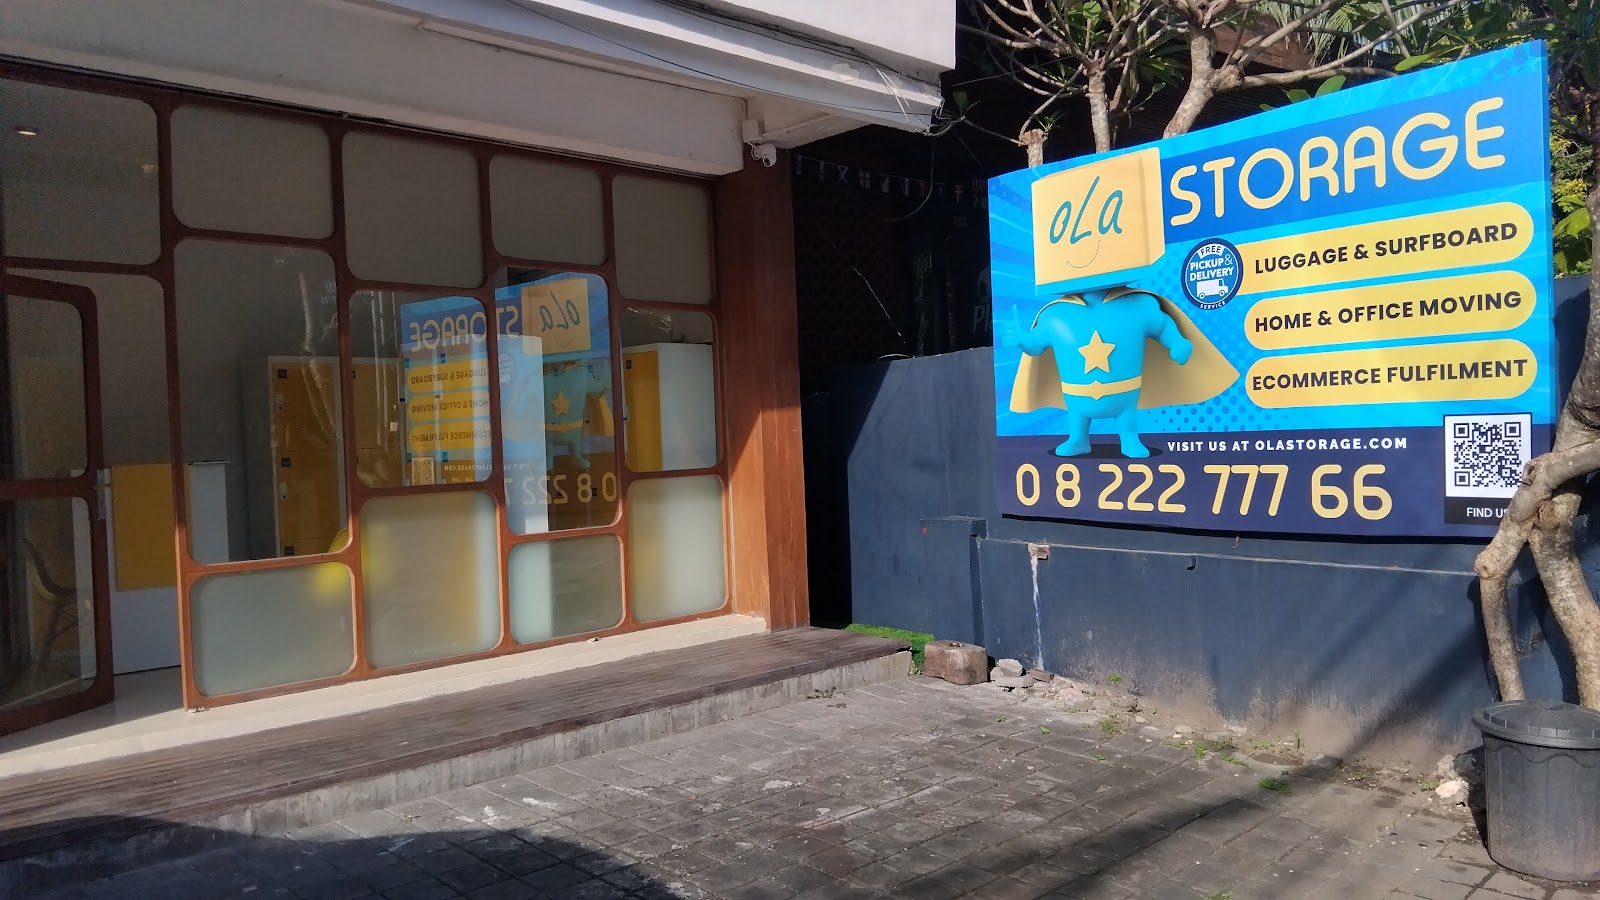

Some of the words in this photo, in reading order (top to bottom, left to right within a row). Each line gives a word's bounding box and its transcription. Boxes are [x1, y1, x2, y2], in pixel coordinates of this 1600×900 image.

[1169, 96, 1506, 227] STORAGE
[1200, 245, 1222, 256] FREE
[1255, 246, 1348, 275] LUGGAGE
[1353, 243, 1370, 260] &
[1375, 222, 1518, 257] SURFBOARD
[1189, 266, 1234, 282] DELIVERY
[972, 304, 992, 334] Pl
[1200, 301, 1226, 310] SERVICE
[1255, 310, 1311, 332] HOME
[1317, 310, 1333, 327] &
[1338, 301, 1413, 323] OFFICE
[1419, 290, 1522, 317] MOVING
[1252, 367, 1381, 391] ECOMMERCE
[1387, 358, 1528, 383] FULFILMENT
[1167, 441, 1203, 452] VISIT
[1208, 440, 1227, 451] US
[1232, 440, 1250, 451] AT
[1255, 437, 1407, 451] OLASTORAGE.COM
[1016, 463, 1041, 506] 0
[1056, 463, 1081, 508] 8
[1098, 463, 1186, 513] 222
[1203, 464, 1289, 517] 777
[1311, 463, 1393, 520] 66
[1466, 507, 1493, 518] FIND
